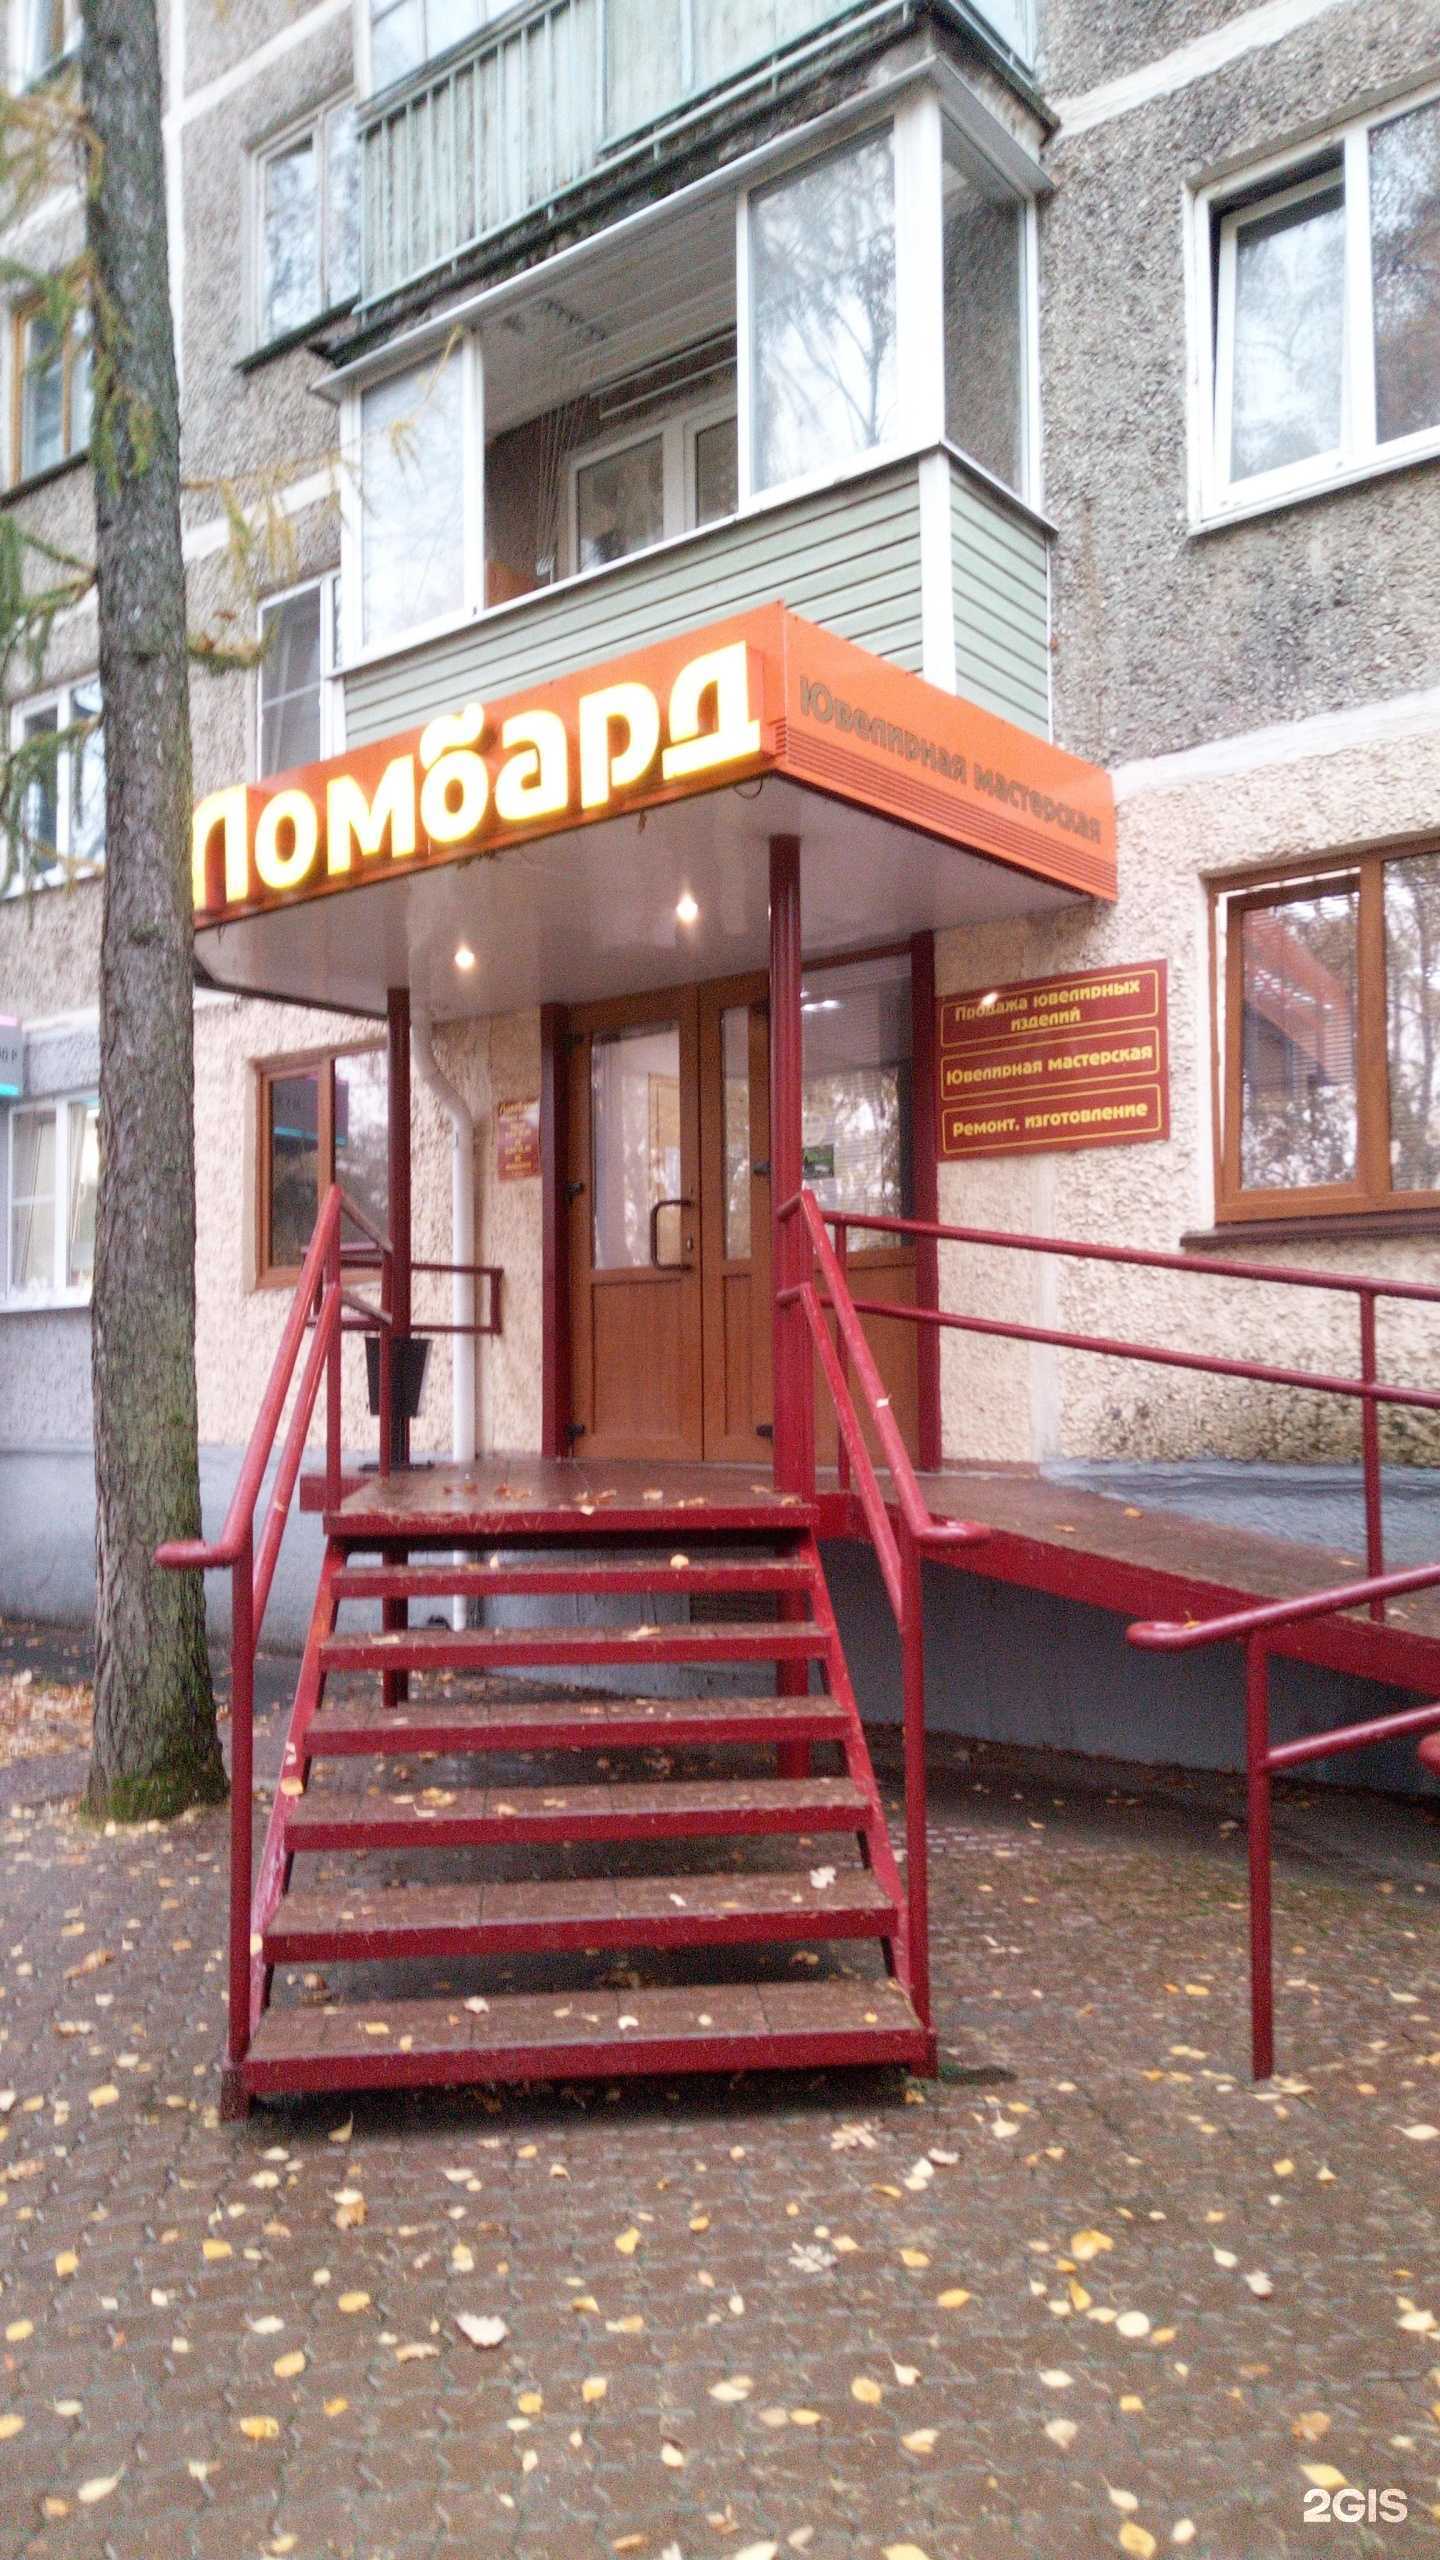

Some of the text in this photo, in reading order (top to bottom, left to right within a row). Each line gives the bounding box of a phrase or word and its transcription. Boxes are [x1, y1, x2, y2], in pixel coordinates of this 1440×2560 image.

[191, 640, 761, 911] Ломбард
[799, 676, 1102, 845] Ювелирная мастерская
[954, 980, 1141, 1022] Продажа ювелирных
[1010, 1006, 1081, 1032] изделий
[946, 1045, 1153, 1086] Ювелирная мастерская
[1025, 1103, 1149, 1129] изготовление
